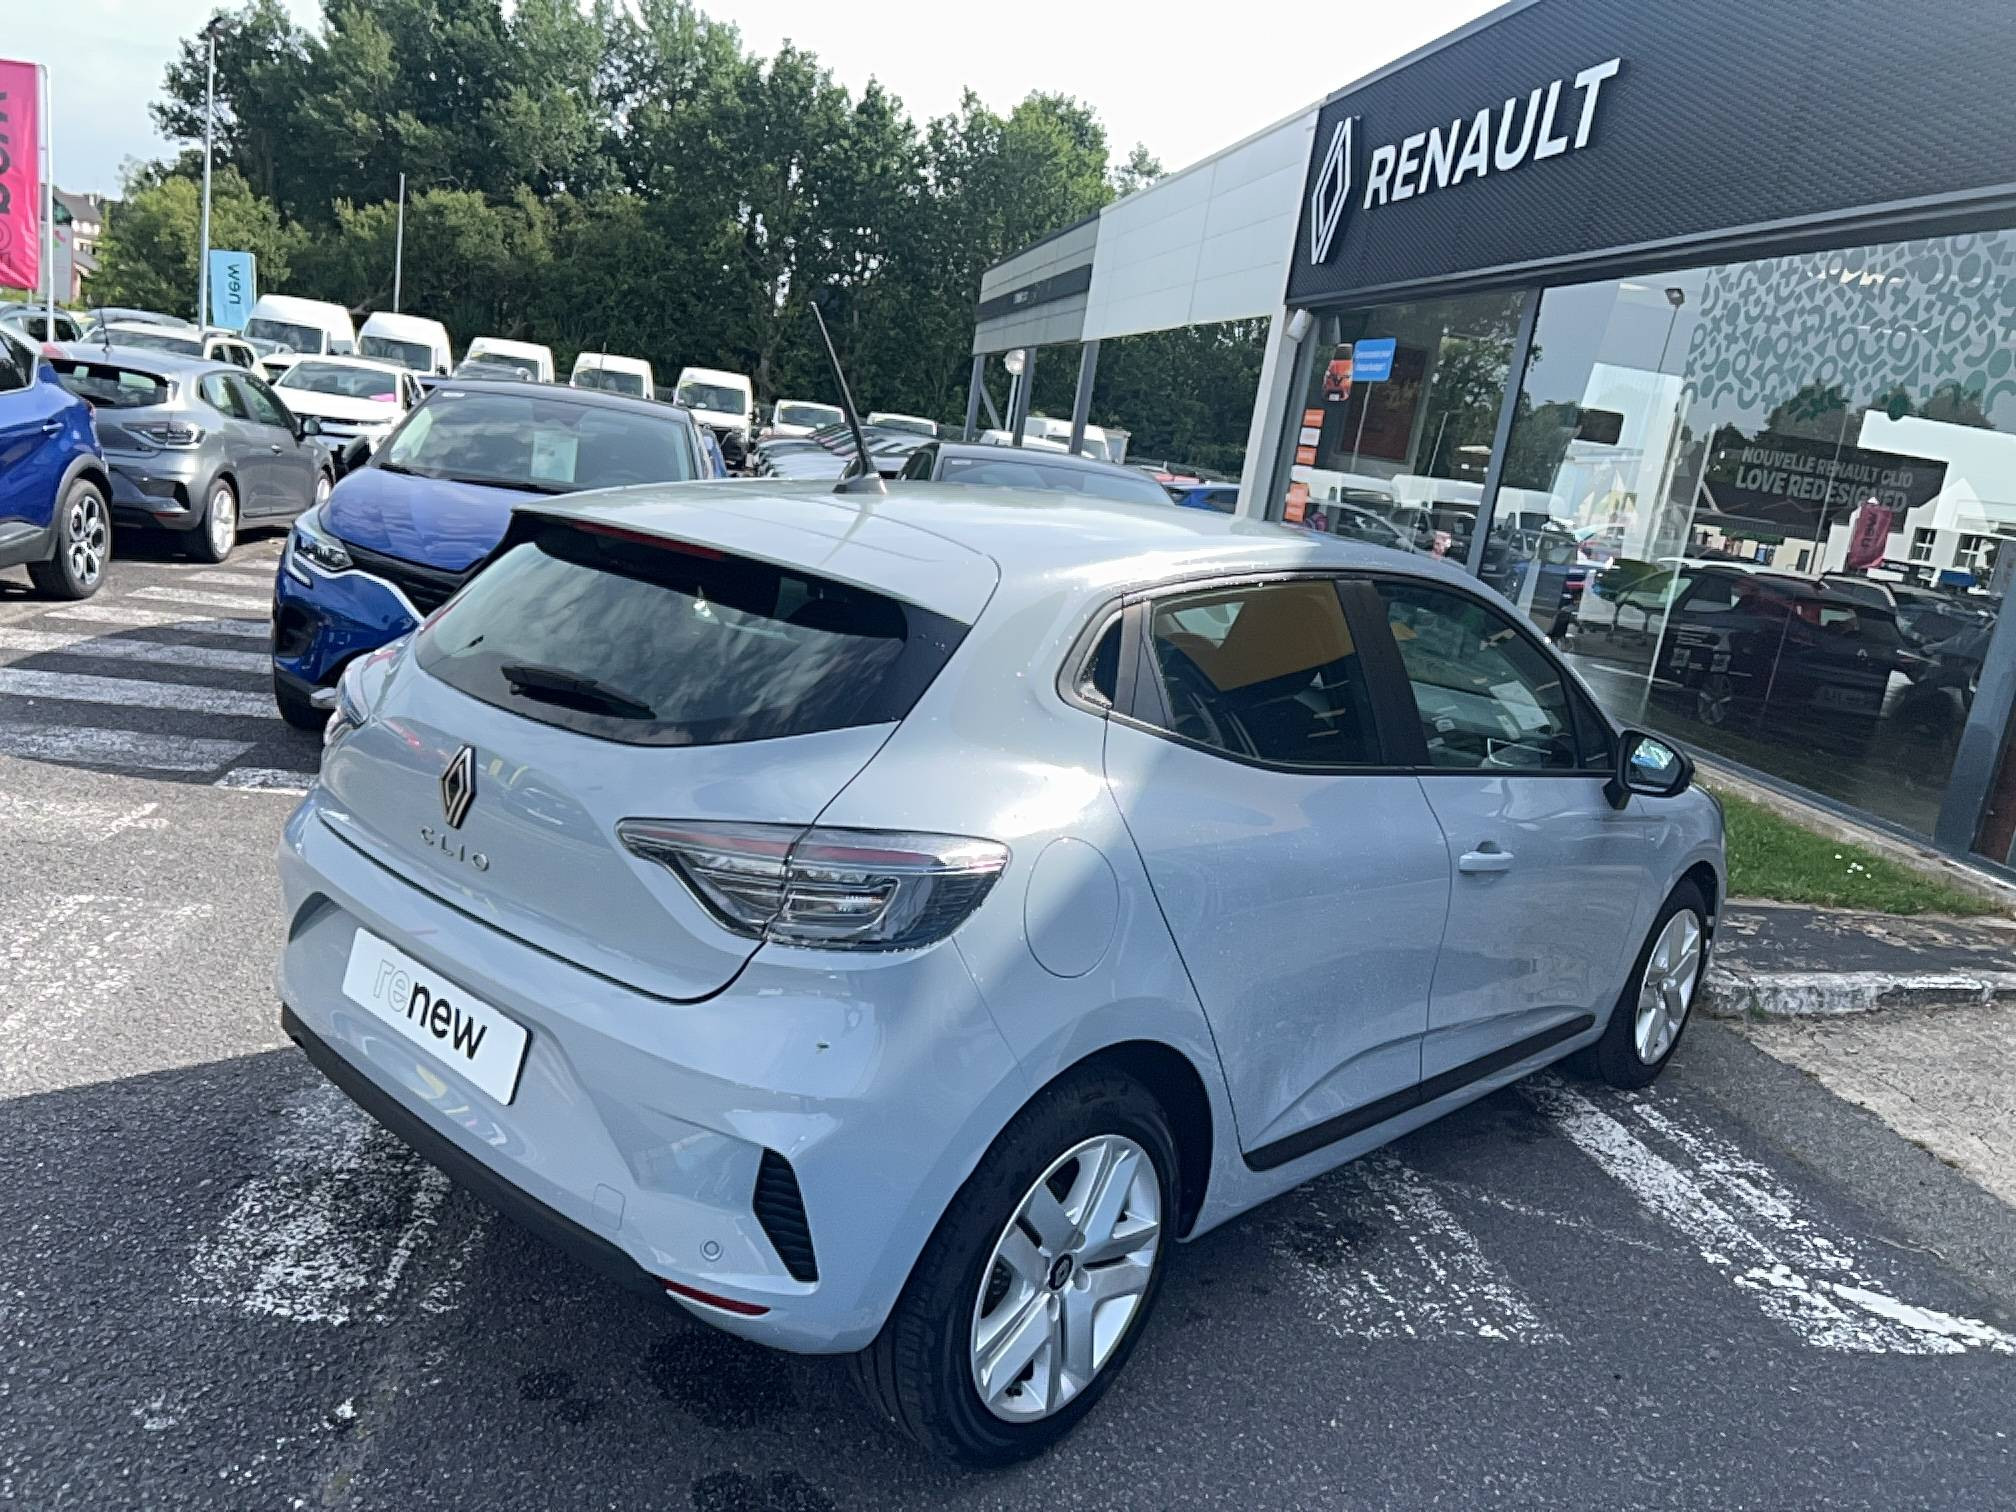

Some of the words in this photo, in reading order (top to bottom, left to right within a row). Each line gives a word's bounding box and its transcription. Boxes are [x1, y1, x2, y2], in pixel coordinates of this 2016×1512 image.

[1363, 57, 1621, 210] RENAULT
[1735, 465, 1788, 494] LOVE
[1741, 446, 1816, 473] NOUVELLE
[1816, 459, 1881, 483] RENAULT
[1880, 470, 1913, 488] CLIO
[421, 826, 490, 871] CLIO
[373, 958, 488, 1061] renew
